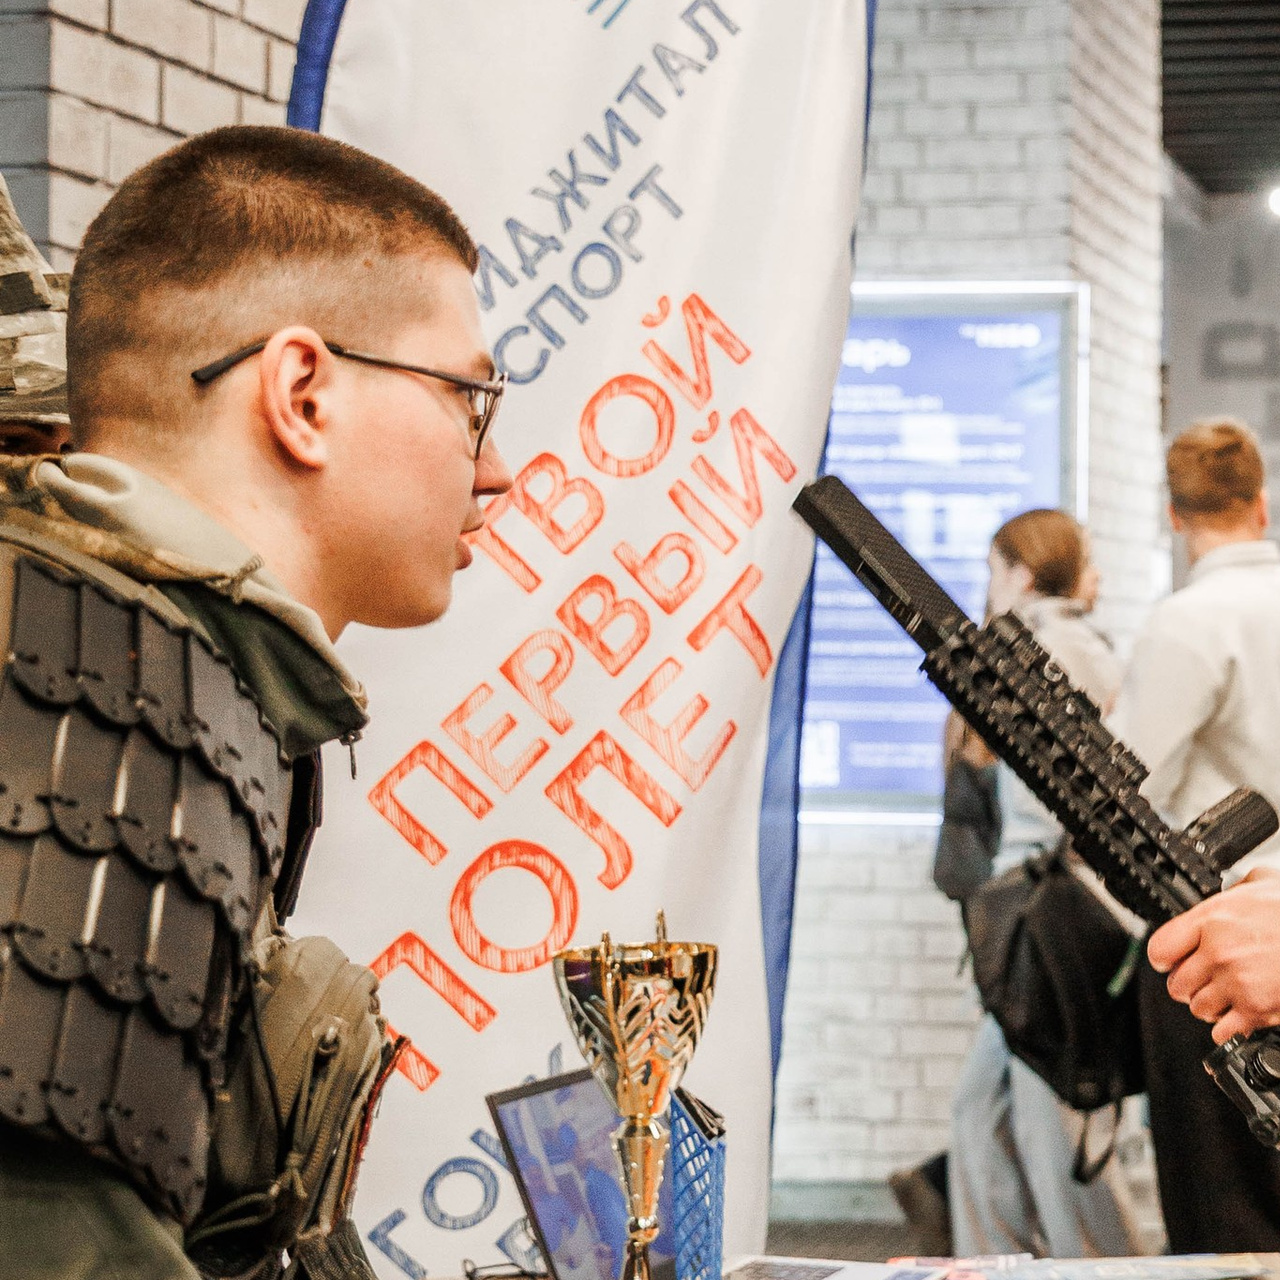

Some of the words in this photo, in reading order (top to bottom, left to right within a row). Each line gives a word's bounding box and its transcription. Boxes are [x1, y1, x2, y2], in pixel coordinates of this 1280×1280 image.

[460, 292, 752, 595] ТВОЙ
[492, 163, 684, 386] СПОРТ
[366, 406, 798, 868] ПЕРВЫЙ
[367, 562, 774, 1094] ПОЛЕТ
